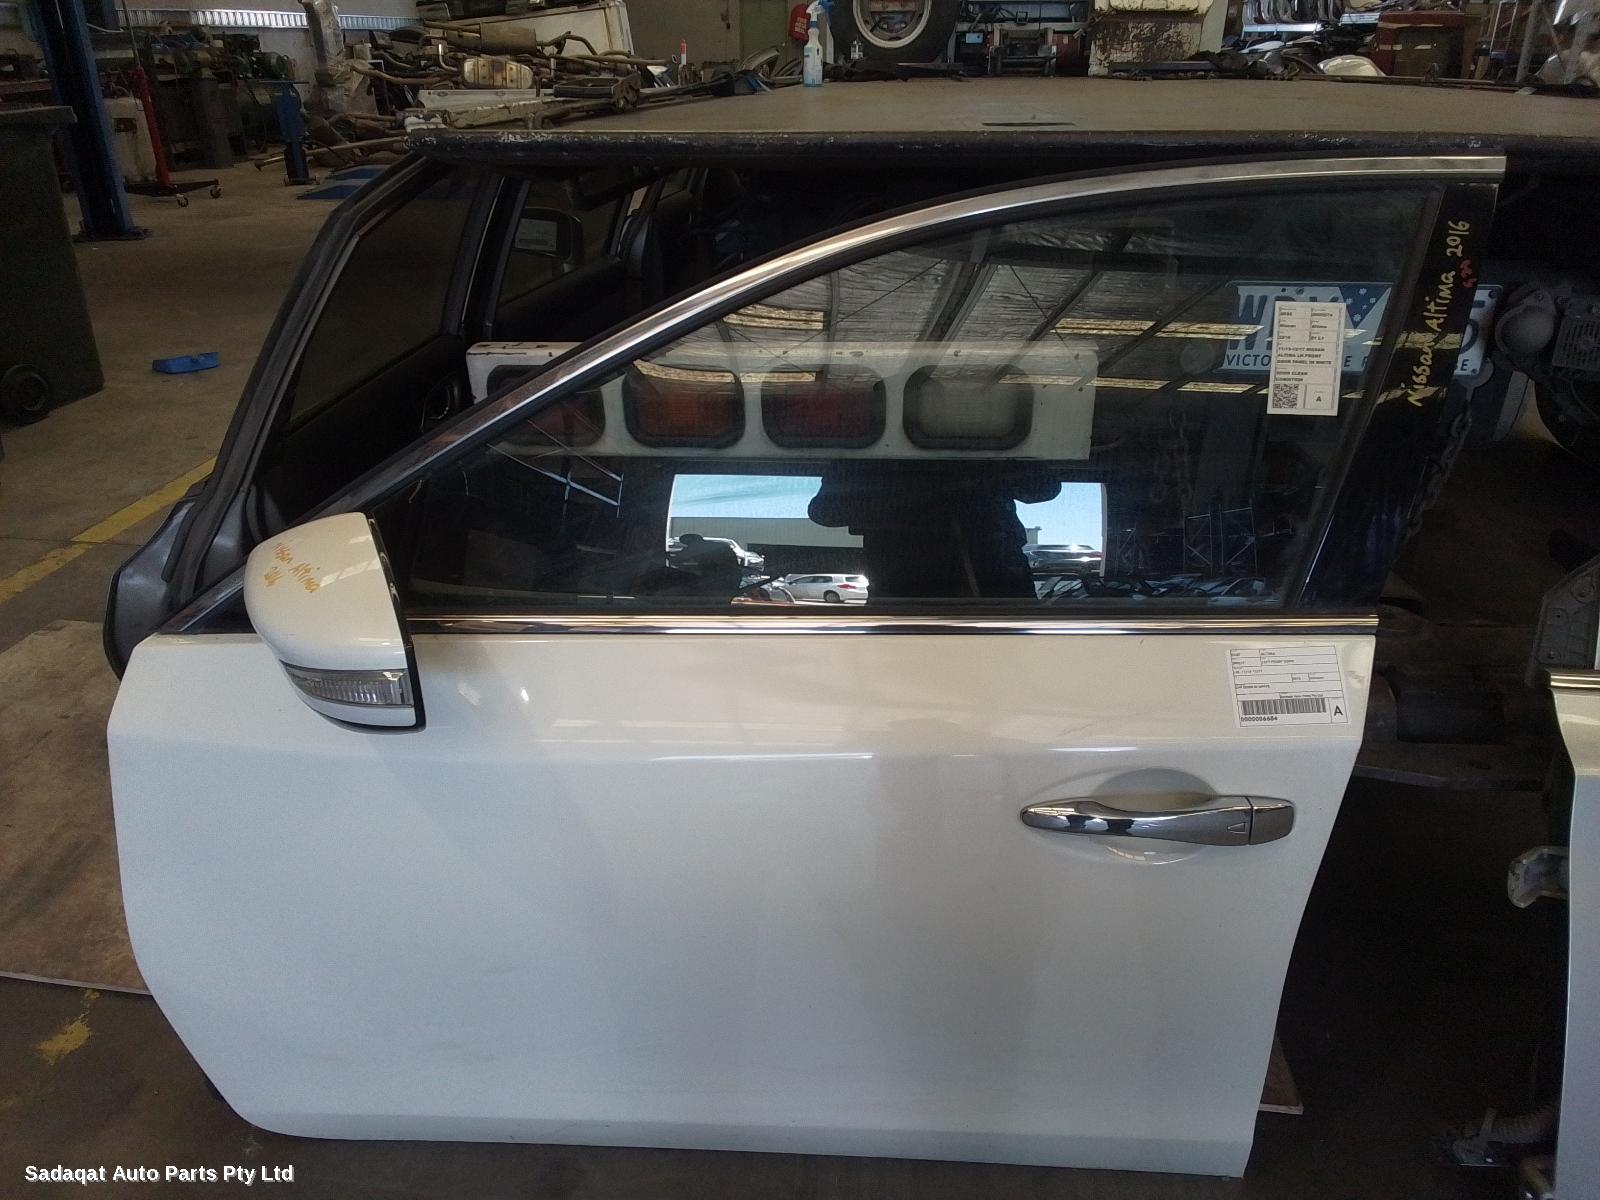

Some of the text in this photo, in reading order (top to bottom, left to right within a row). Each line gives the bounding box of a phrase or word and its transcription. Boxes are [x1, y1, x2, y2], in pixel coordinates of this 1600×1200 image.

[1401, 341, 1435, 407] Nissan
[1423, 270, 1455, 332] Altima
[1446, 220, 1470, 257] 2016
[1226, 354, 1271, 367] VICTO
[1334, 705, 1343, 716] A
